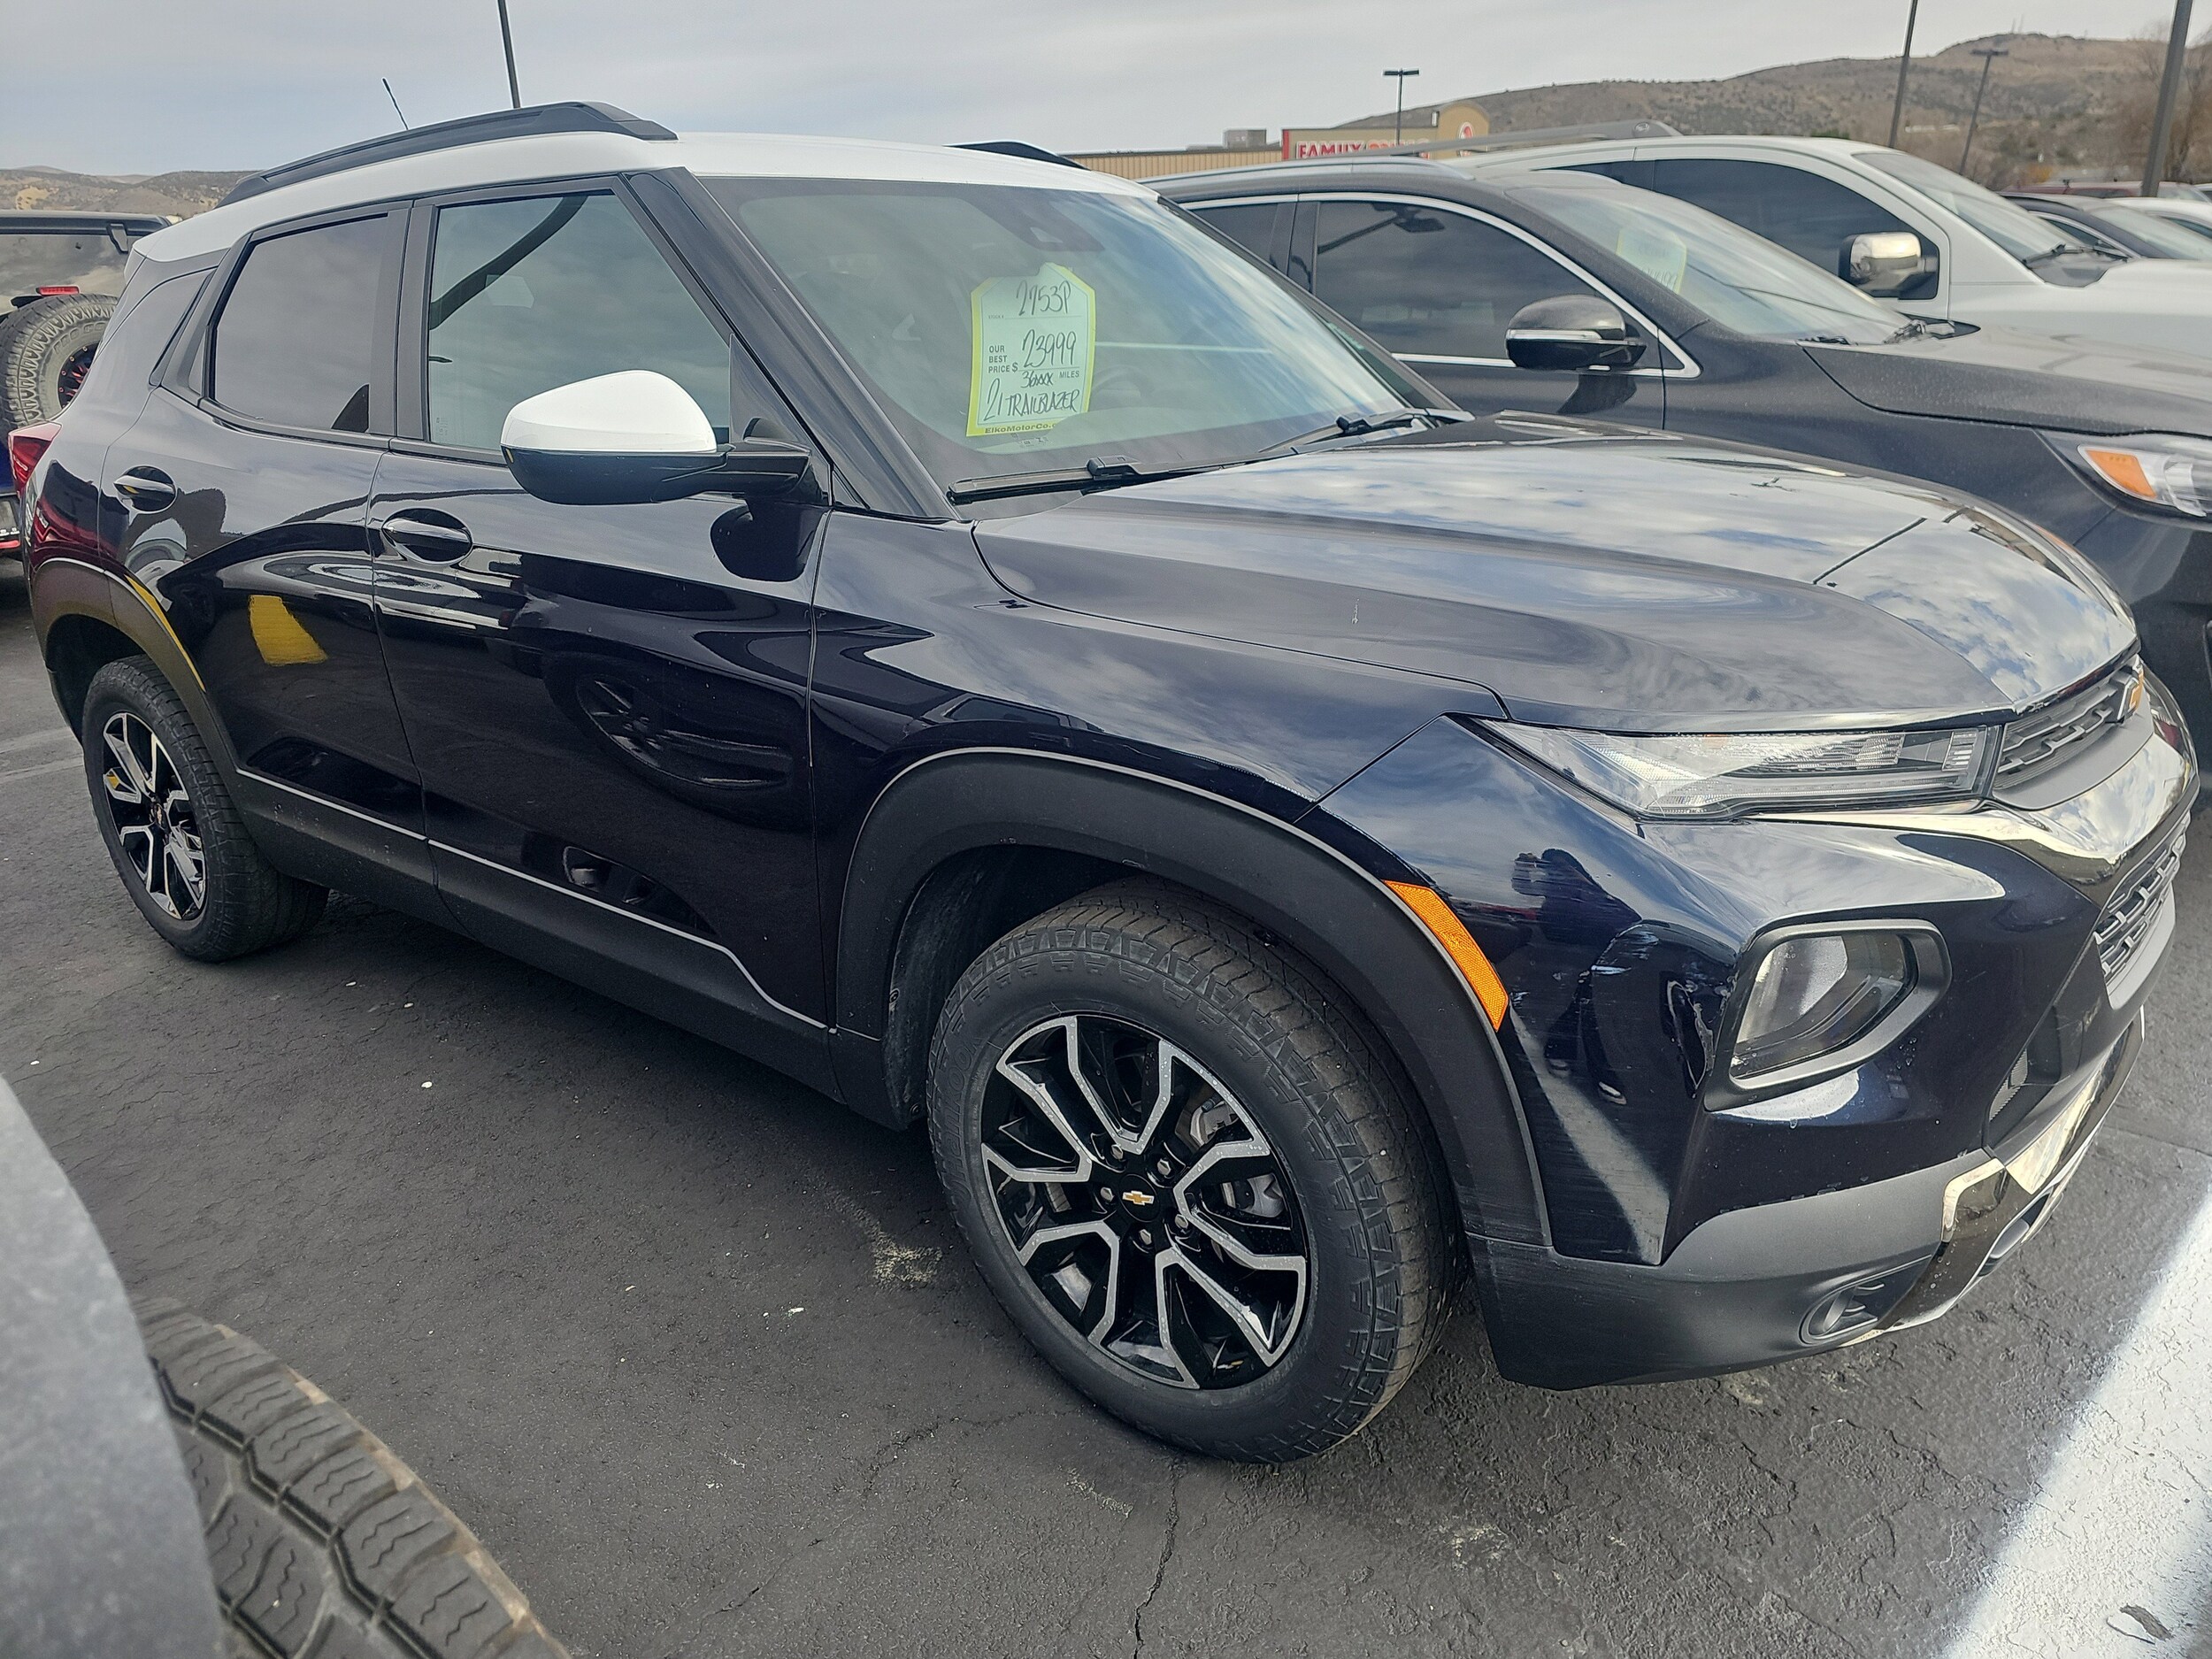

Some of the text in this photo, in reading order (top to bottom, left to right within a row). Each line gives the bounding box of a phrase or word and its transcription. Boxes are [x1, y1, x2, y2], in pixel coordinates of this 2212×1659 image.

[1022, 329, 1077, 368] 23999
[988, 365, 1010, 373] PRICE
[1059, 370, 1079, 379] MILES
[983, 378, 1003, 421] 21
